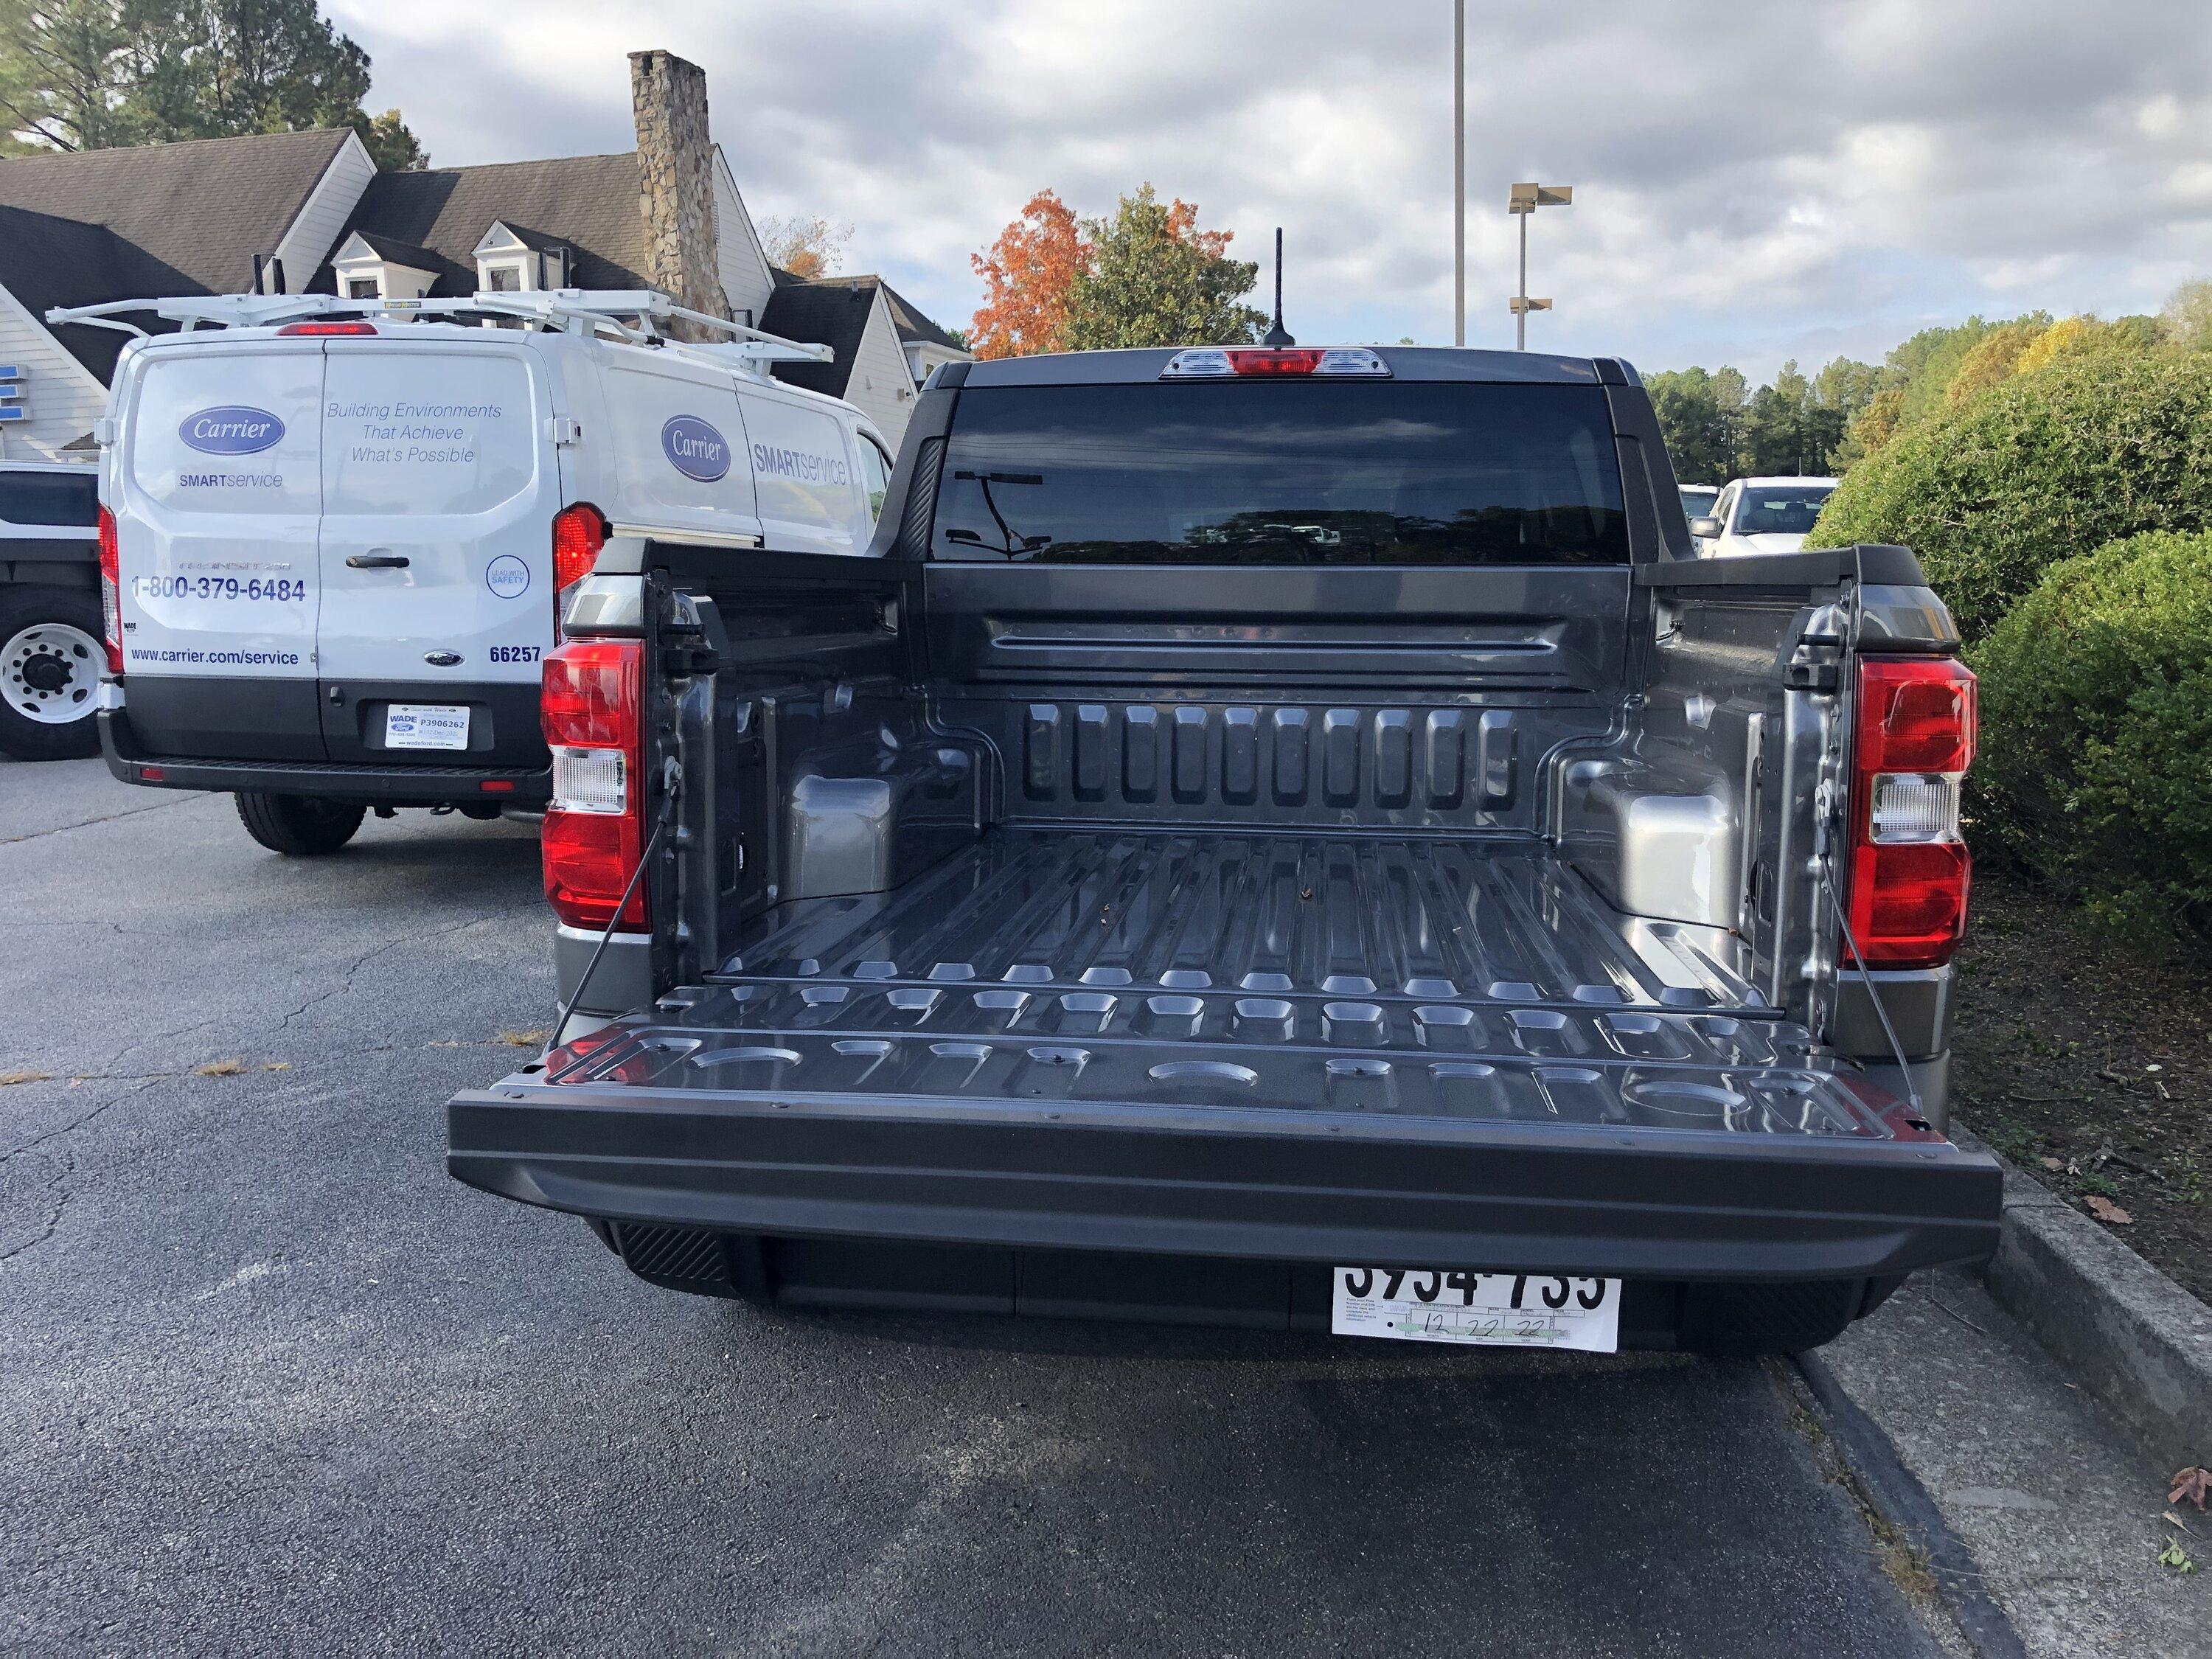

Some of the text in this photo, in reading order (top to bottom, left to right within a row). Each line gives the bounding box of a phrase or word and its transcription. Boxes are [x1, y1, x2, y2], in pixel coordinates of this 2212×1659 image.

[327, 402, 502, 421] Building Environments
[194, 418, 271, 439] Carrier
[364, 425, 464, 440] That Achieve
[672, 429, 721, 462] Carrier
[352, 447, 474, 463] What's Possible
[754, 443, 846, 486] SMARTservice
[179, 470, 282, 487] SMARTservice
[131, 576, 306, 602] 1-800-379-6484
[131, 648, 299, 664] www.carrier.com/service
[490, 646, 540, 662] 66257
[389, 715, 417, 723] WADE
[420, 719, 465, 728] P3906262
[1424, 1312, 1545, 1338] 12 22 22
